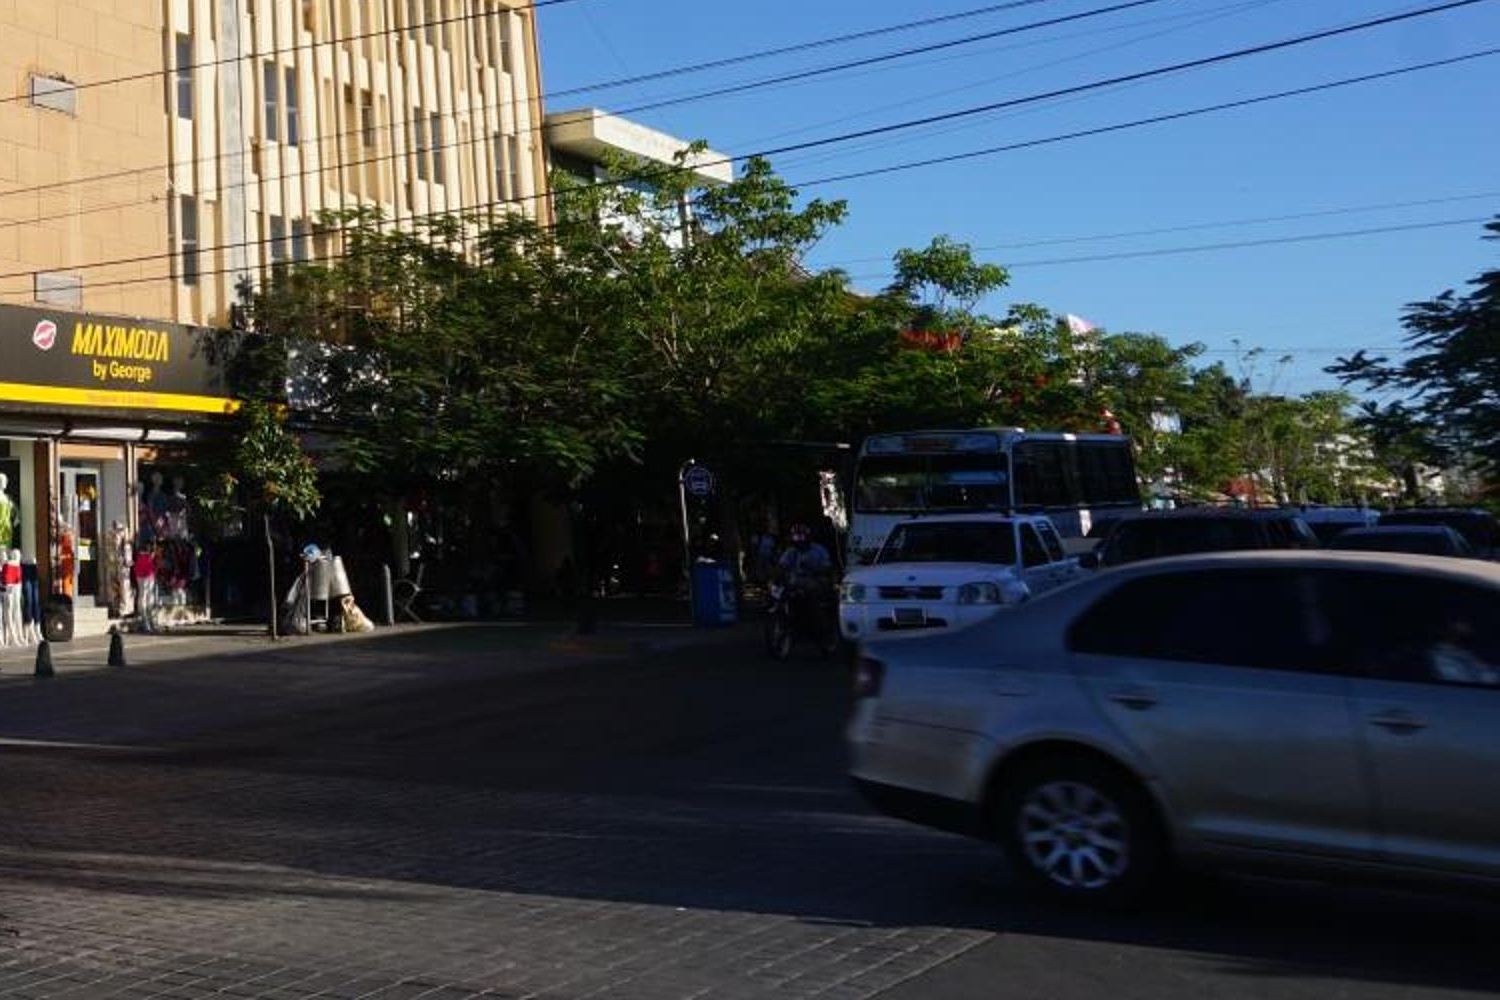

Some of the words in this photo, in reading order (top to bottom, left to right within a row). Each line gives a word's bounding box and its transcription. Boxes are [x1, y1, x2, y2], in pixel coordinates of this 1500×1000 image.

[71, 323, 169, 361] MAXIMODA
[92, 361, 110, 379] by
[110, 362, 152, 382] George
